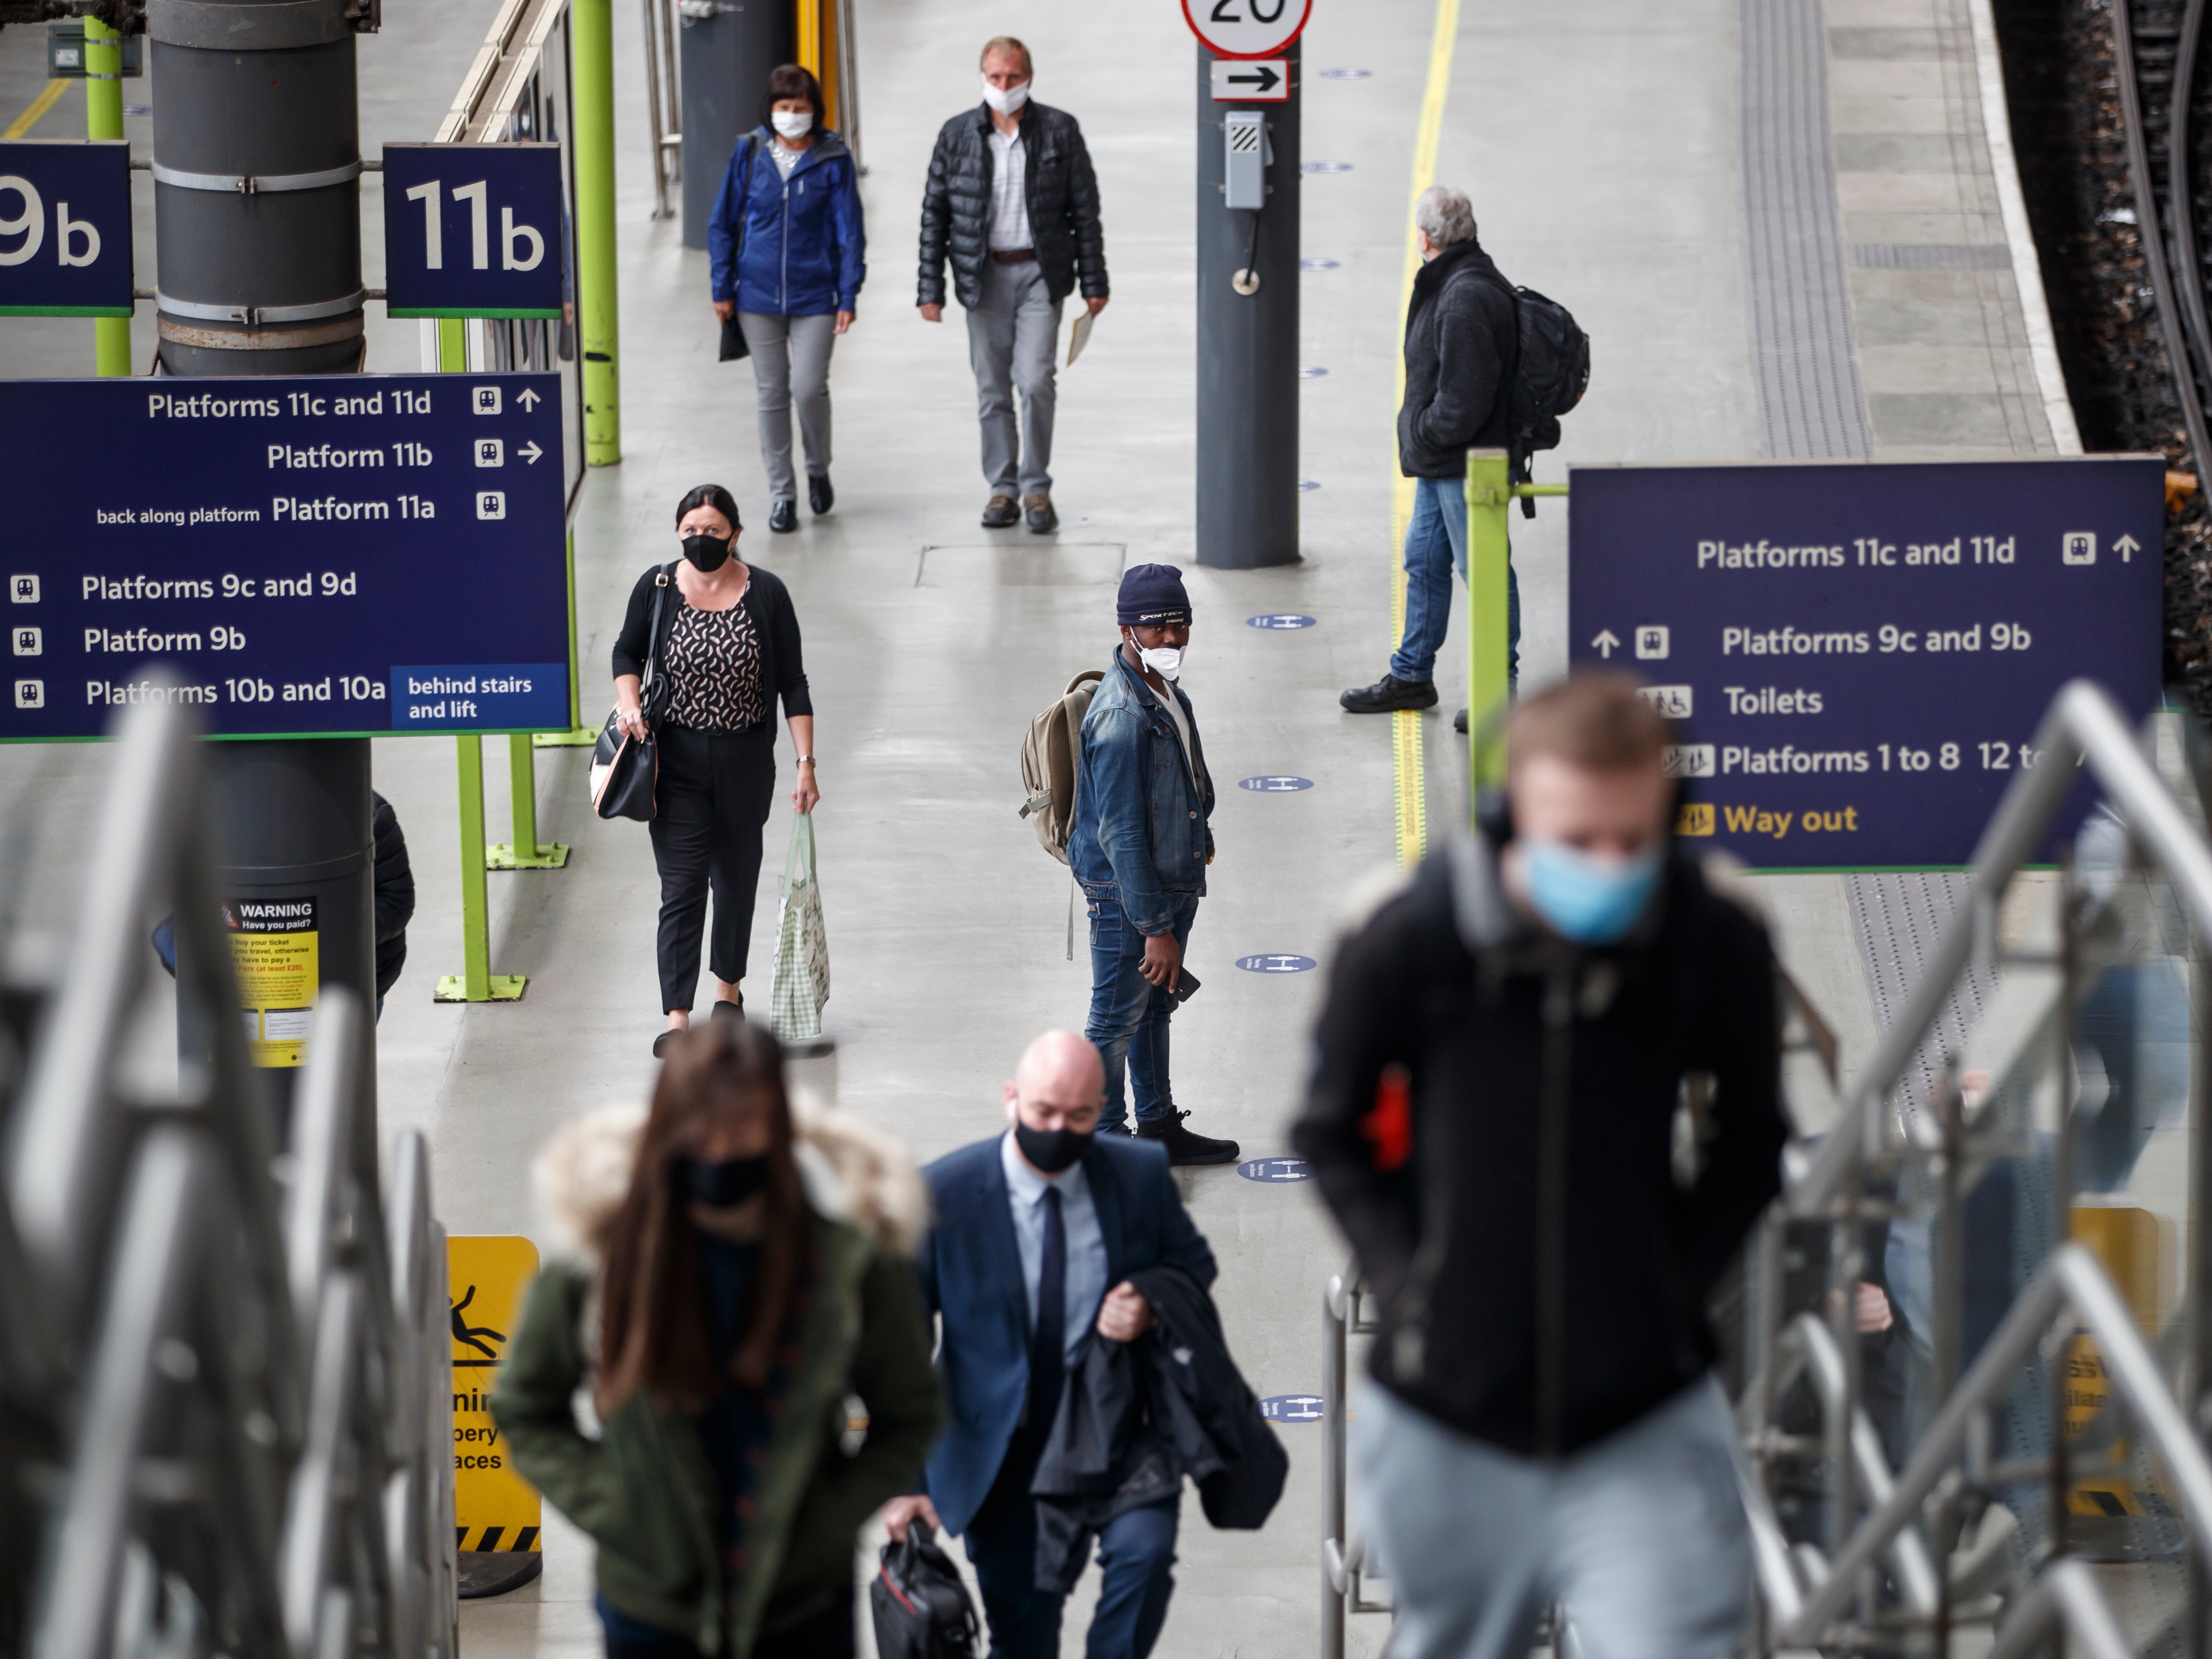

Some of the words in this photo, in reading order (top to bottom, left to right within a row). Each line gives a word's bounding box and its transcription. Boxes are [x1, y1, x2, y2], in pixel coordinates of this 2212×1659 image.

[0, 176, 100, 267] 9b
[406, 180, 545, 271] 11b
[149, 394, 280, 418] Platforms
[287, 393, 326, 416] 11c
[334, 391, 383, 415] and
[391, 390, 431, 414] 11d
[268, 444, 384, 469] Platform
[392, 443, 432, 466] 11b
[97, 509, 136, 524] back
[140, 509, 185, 526] along
[190, 507, 260, 526] platform
[273, 496, 389, 521] Platform
[397, 495, 435, 519] 11a
[1698, 540, 1844, 568] Platforms
[1854, 539, 1896, 565] 11c
[1905, 538, 1960, 565] and
[1971, 537, 2014, 563] 11d
[83, 575, 214, 600] Platforms
[222, 574, 256, 598] 9c
[264, 573, 312, 597] and
[321, 572, 356, 596] 9d
[85, 628, 201, 652] Platform
[210, 626, 246, 650] 9b
[1723, 627, 1870, 655] Platforms
[1879, 625, 1916, 652] 9c
[1926, 624, 1981, 651] and
[1990, 623, 2031, 650] 9b
[87, 680, 217, 704] Platforms
[225, 679, 274, 702] 10b
[283, 677, 331, 701] and
[339, 676, 385, 700] 10a
[409, 677, 476, 694] behind
[481, 676, 532, 693] stairs
[409, 701, 445, 718] and
[451, 701, 477, 718] lift
[1724, 687, 1823, 714] Toilets
[1723, 746, 1869, 773] Platforms
[1878, 744, 1889, 771] 1
[1899, 747, 1930, 771] to
[1940, 743, 1960, 770] 8
[1978, 742, 2010, 769] 12
[1724, 806, 1792, 838] Way
[1803, 807, 1857, 831] out
[240, 903, 312, 918] WARNING
[242, 921, 265, 929] Have
[267, 922, 285, 931] you
[286, 919, 311, 930] paid?
